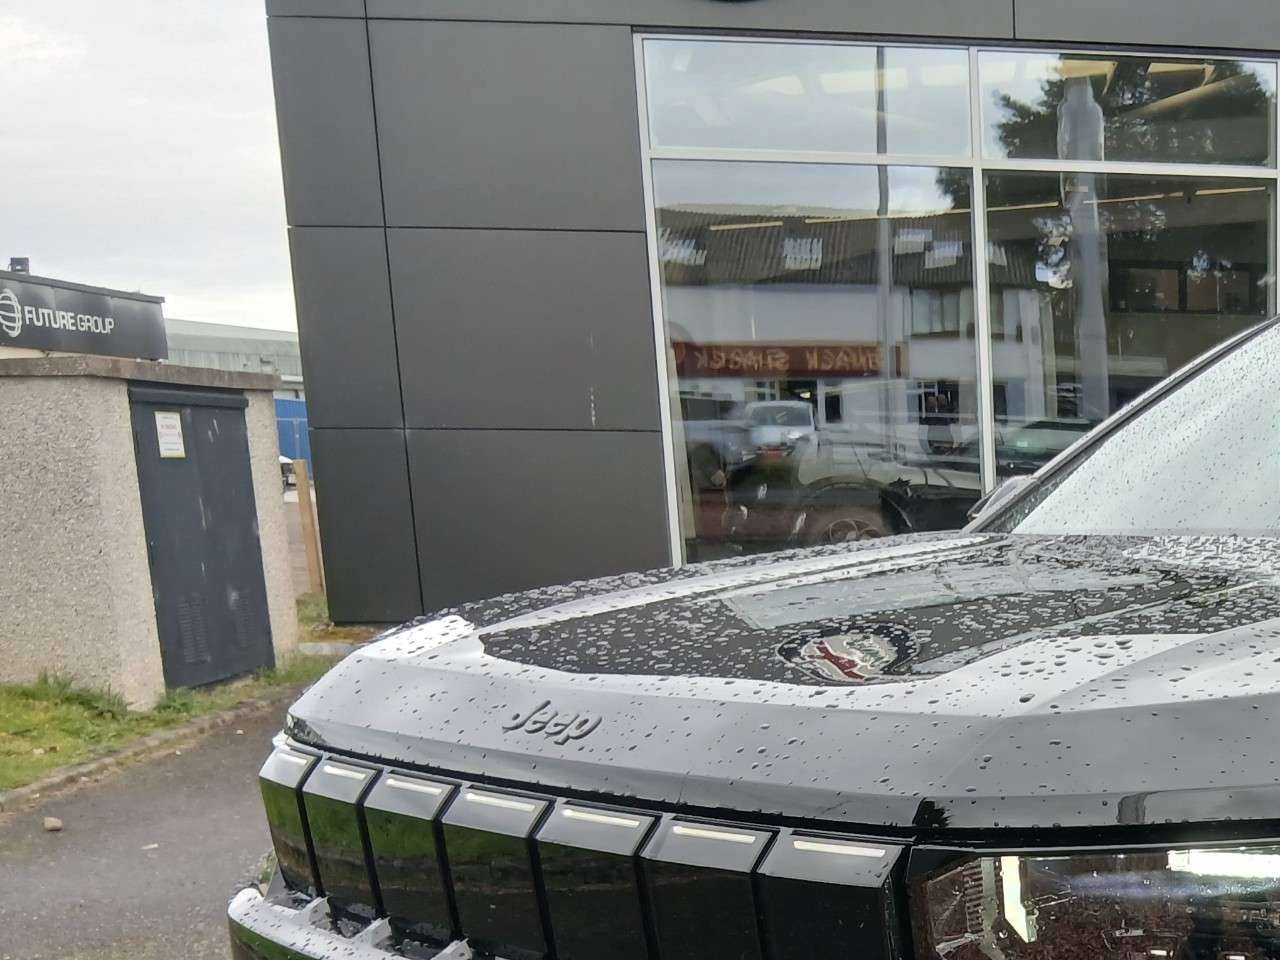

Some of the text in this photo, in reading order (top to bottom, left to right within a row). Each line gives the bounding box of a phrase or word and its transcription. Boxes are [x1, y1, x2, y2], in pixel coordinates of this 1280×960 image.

[24, 305, 114, 334] FUTURE GROUP
[502, 699, 603, 746] Jeep
